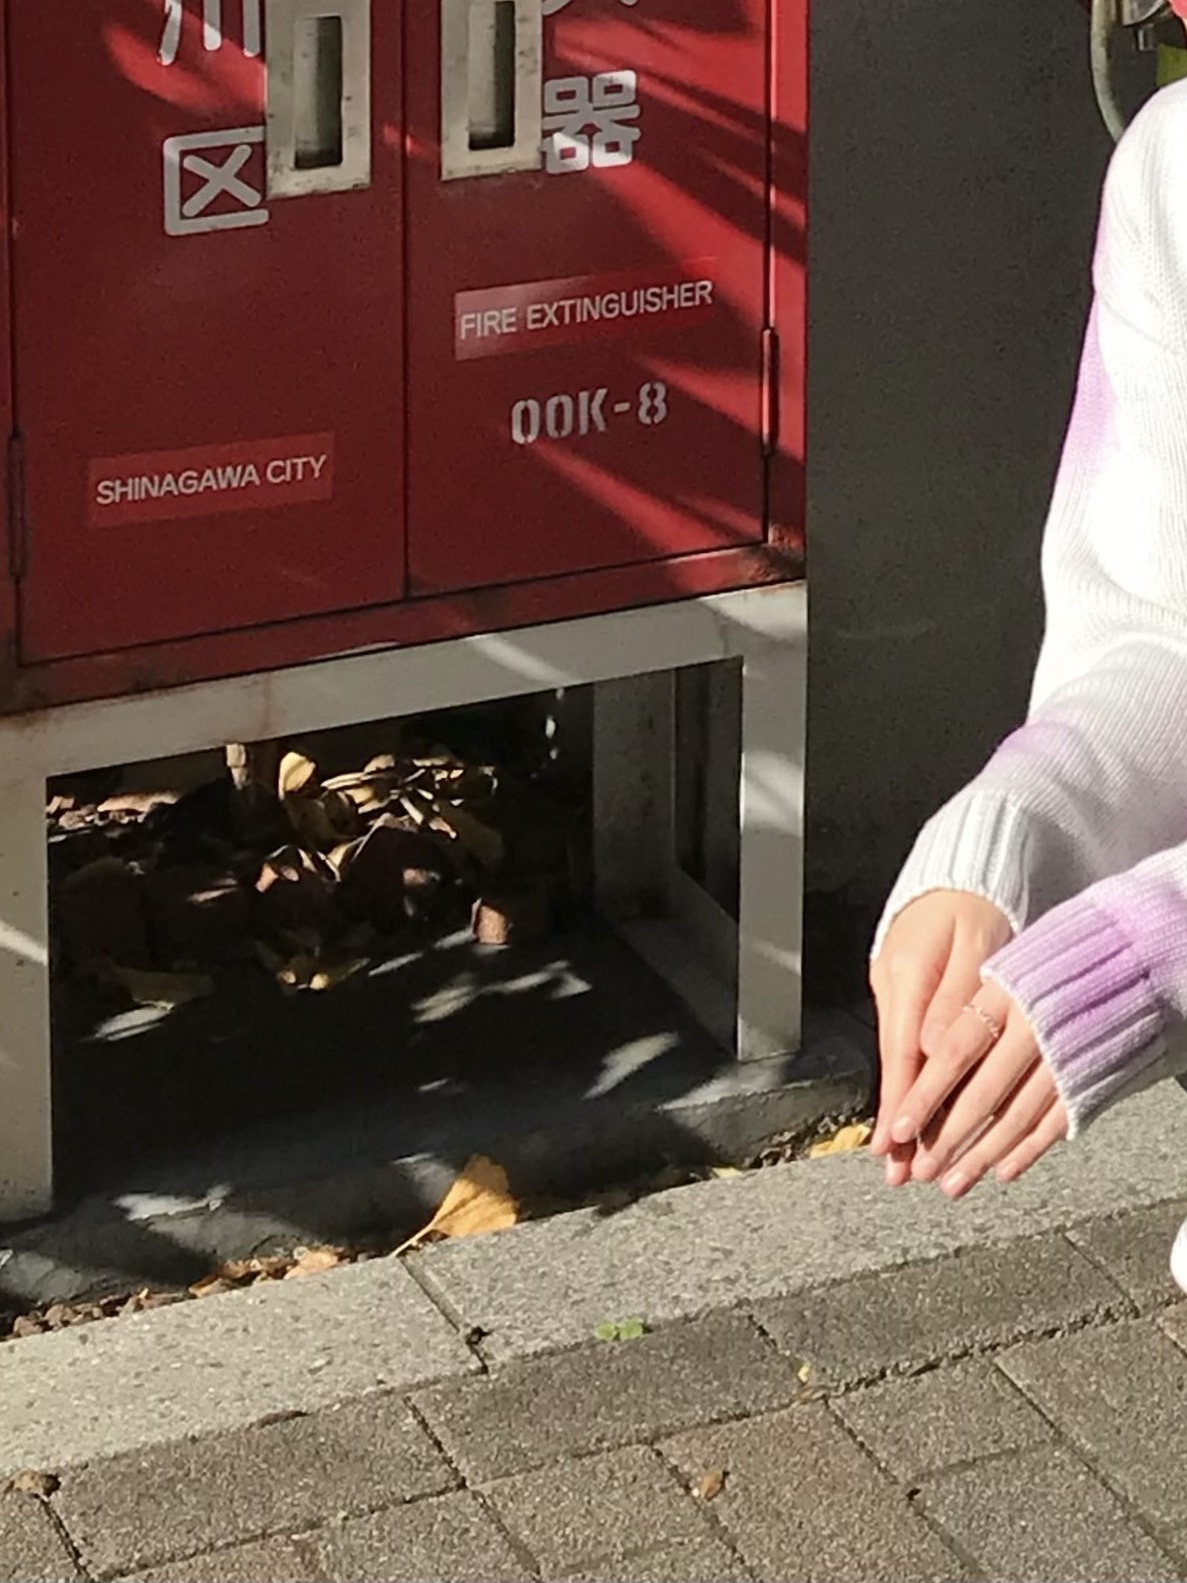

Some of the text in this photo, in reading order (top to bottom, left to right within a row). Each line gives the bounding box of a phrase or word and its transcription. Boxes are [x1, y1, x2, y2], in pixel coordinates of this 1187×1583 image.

[460, 280, 713, 340] FIRE EXTINGUISHER
[96, 455, 327, 505] SHINAGAWA CITY
